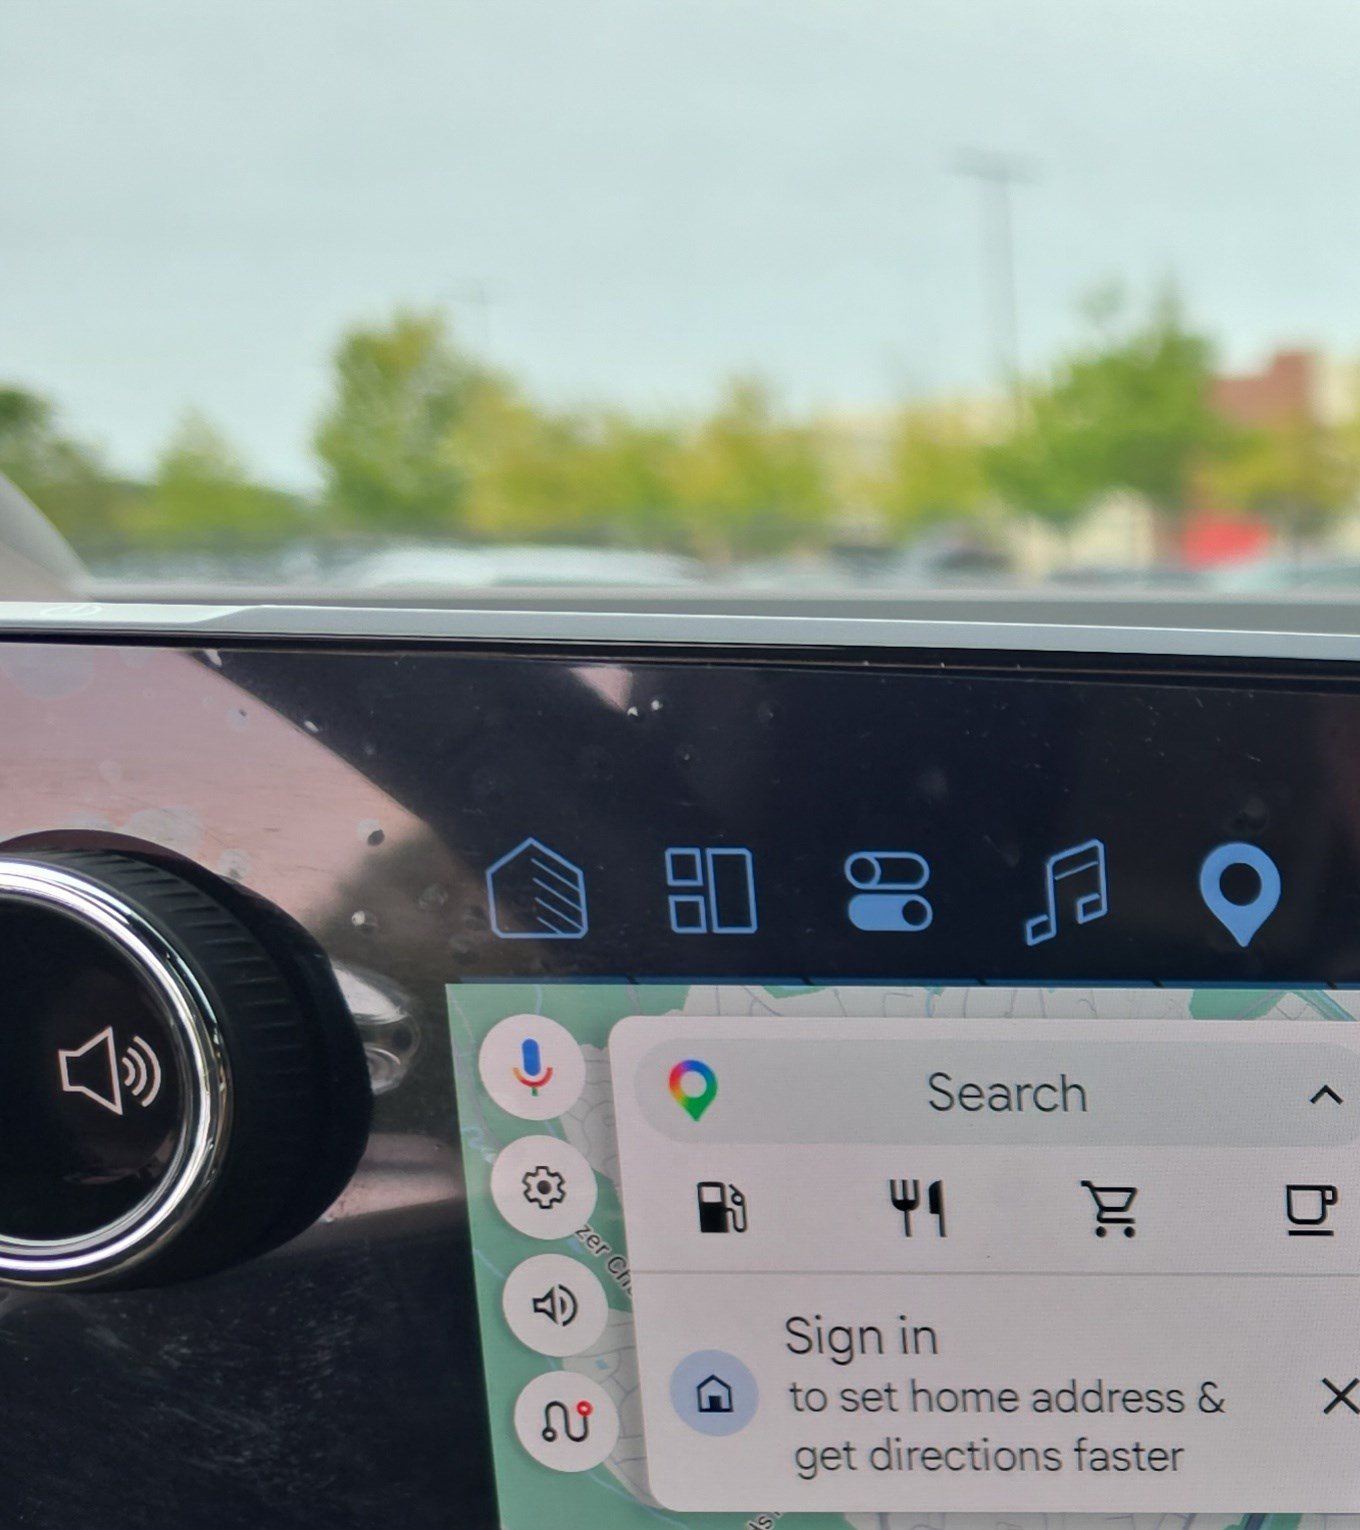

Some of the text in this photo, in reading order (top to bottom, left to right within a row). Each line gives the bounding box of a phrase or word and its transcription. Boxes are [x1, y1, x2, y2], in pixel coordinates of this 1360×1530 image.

[927, 1072, 1088, 1116] Search
[784, 1316, 938, 1365] Sign in
[790, 1380, 1225, 1414] to set home address &
[795, 1438, 1184, 1481] get directions faster
